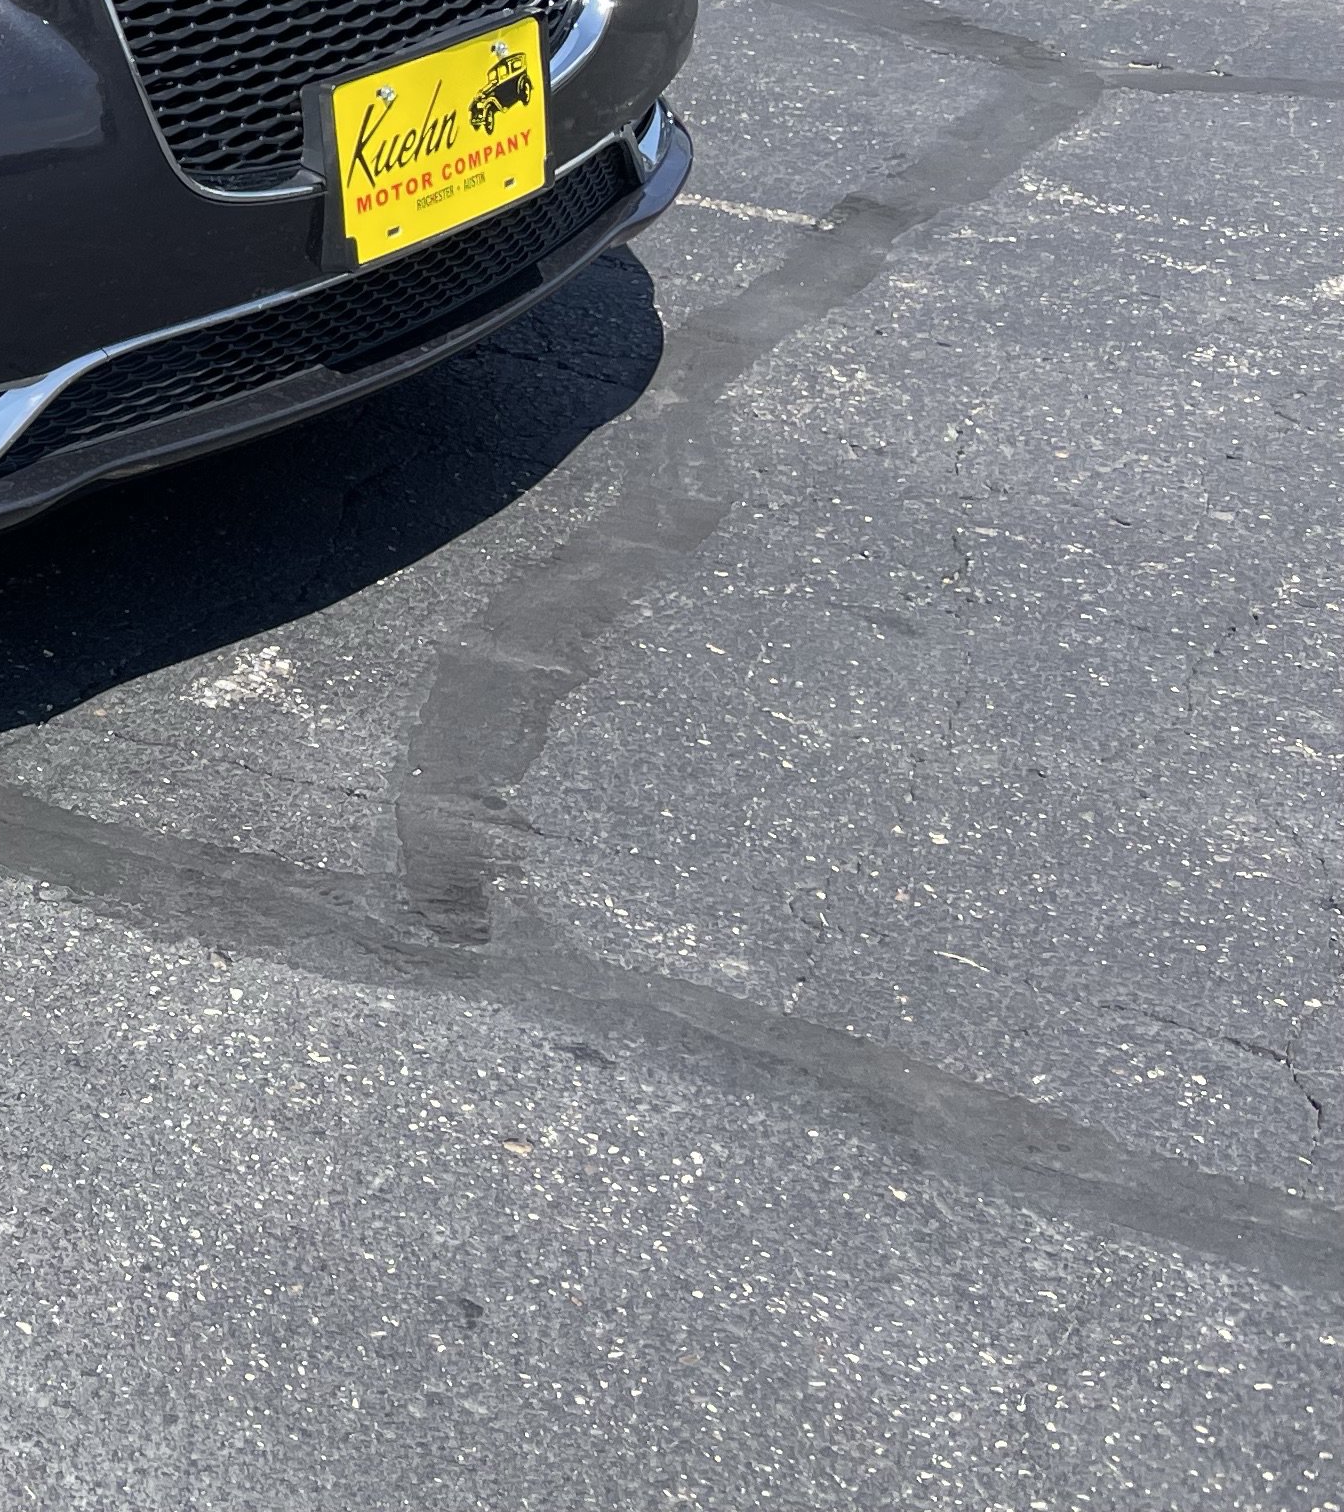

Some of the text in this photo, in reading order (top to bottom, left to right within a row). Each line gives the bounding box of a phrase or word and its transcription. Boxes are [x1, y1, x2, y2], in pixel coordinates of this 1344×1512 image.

[346, 79, 461, 189] Kuehn
[356, 129, 532, 216] MOTOR COMPANY
[416, 184, 454, 212] ROCHESTER
